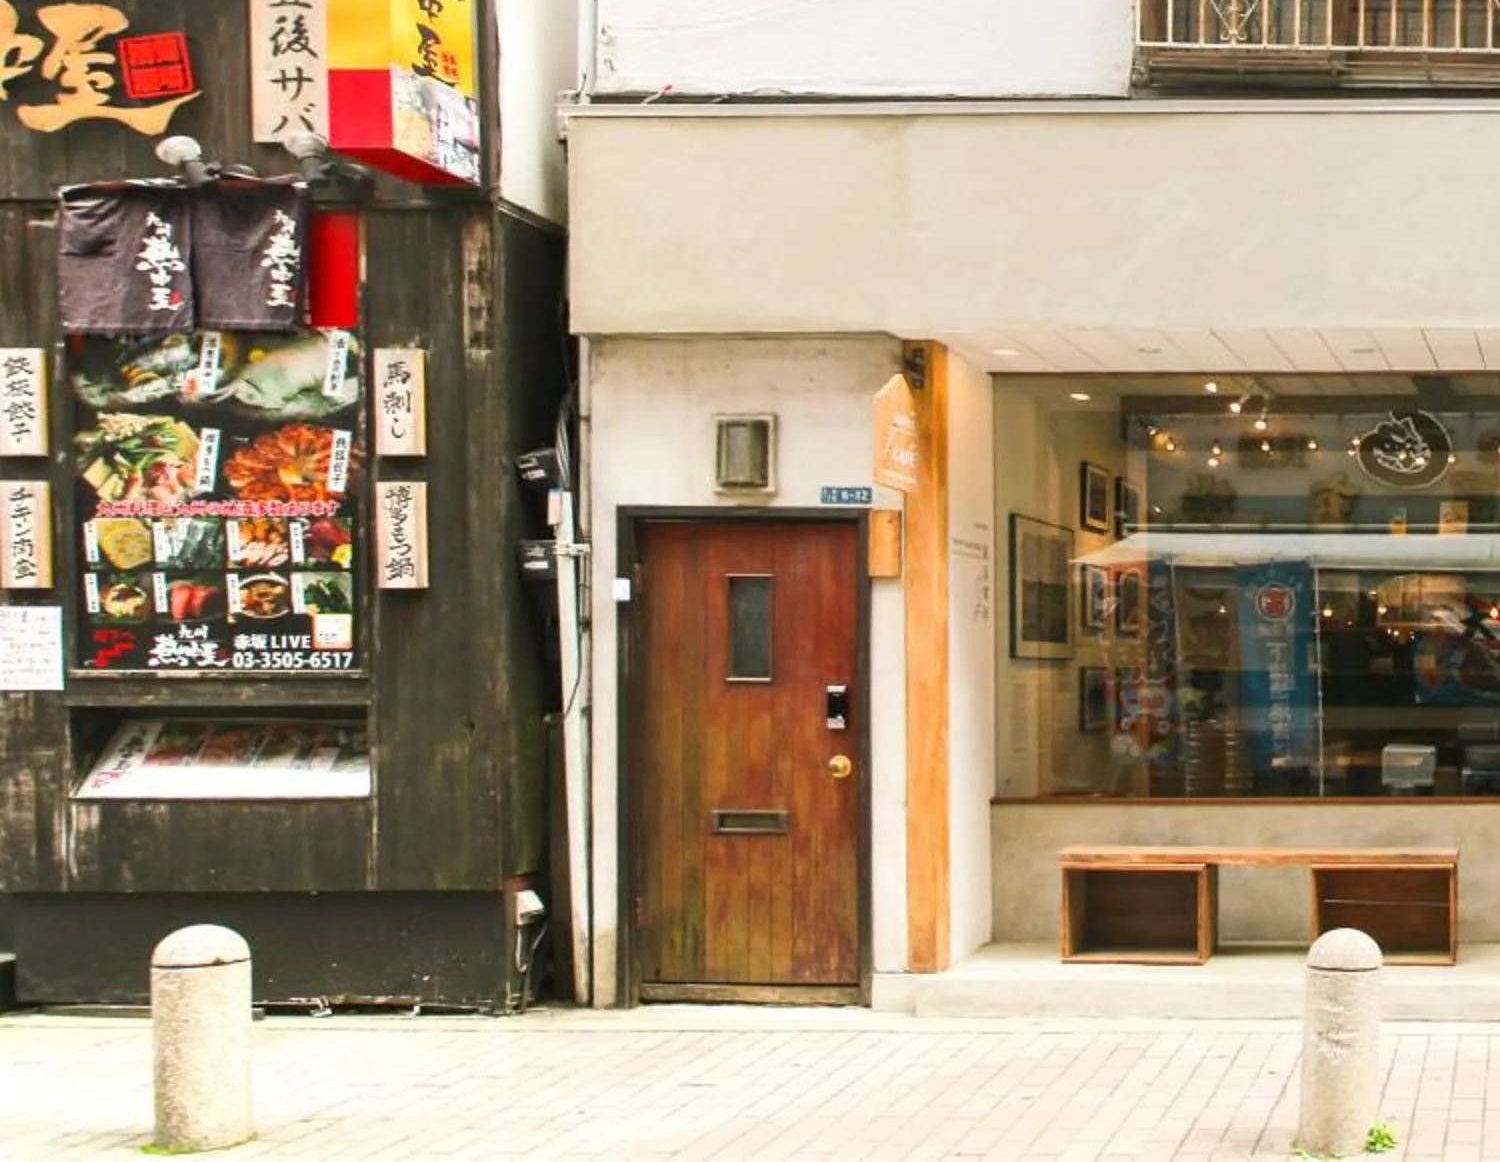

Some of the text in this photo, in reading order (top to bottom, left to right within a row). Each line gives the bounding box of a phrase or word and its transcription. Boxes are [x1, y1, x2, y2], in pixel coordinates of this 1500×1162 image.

[383, 360, 412, 440] 馬刺し
[385, 485, 416, 582] 博多もつ鍋
[232, 651, 354, 669] 03-3505-6517
[270, 634, 312, 649] LIVE
